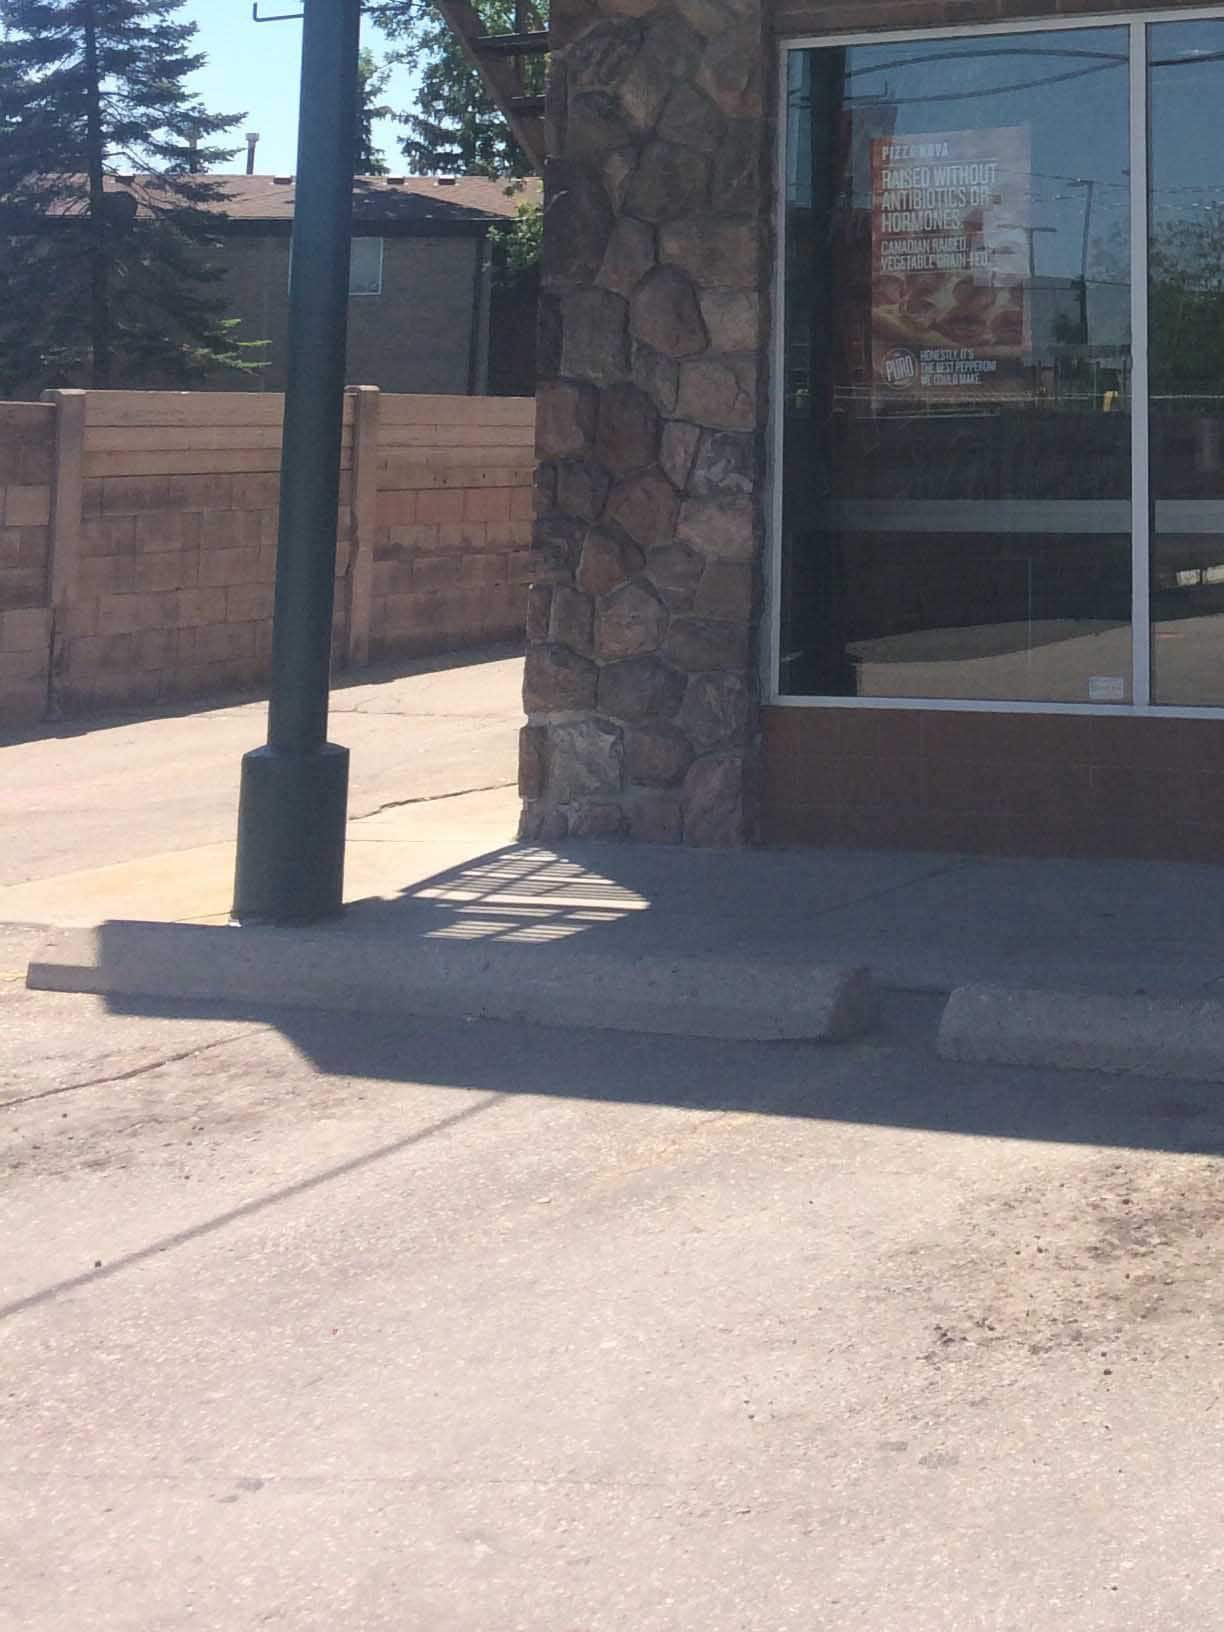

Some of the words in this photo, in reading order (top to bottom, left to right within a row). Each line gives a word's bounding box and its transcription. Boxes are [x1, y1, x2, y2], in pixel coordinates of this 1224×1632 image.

[881, 167, 930, 190] RAISED
[933, 163, 999, 187] WITHOUT
[881, 186, 966, 211] ANTIBIOTICS
[970, 185, 991, 207] OR
[880, 239, 930, 256] CANADIAN
